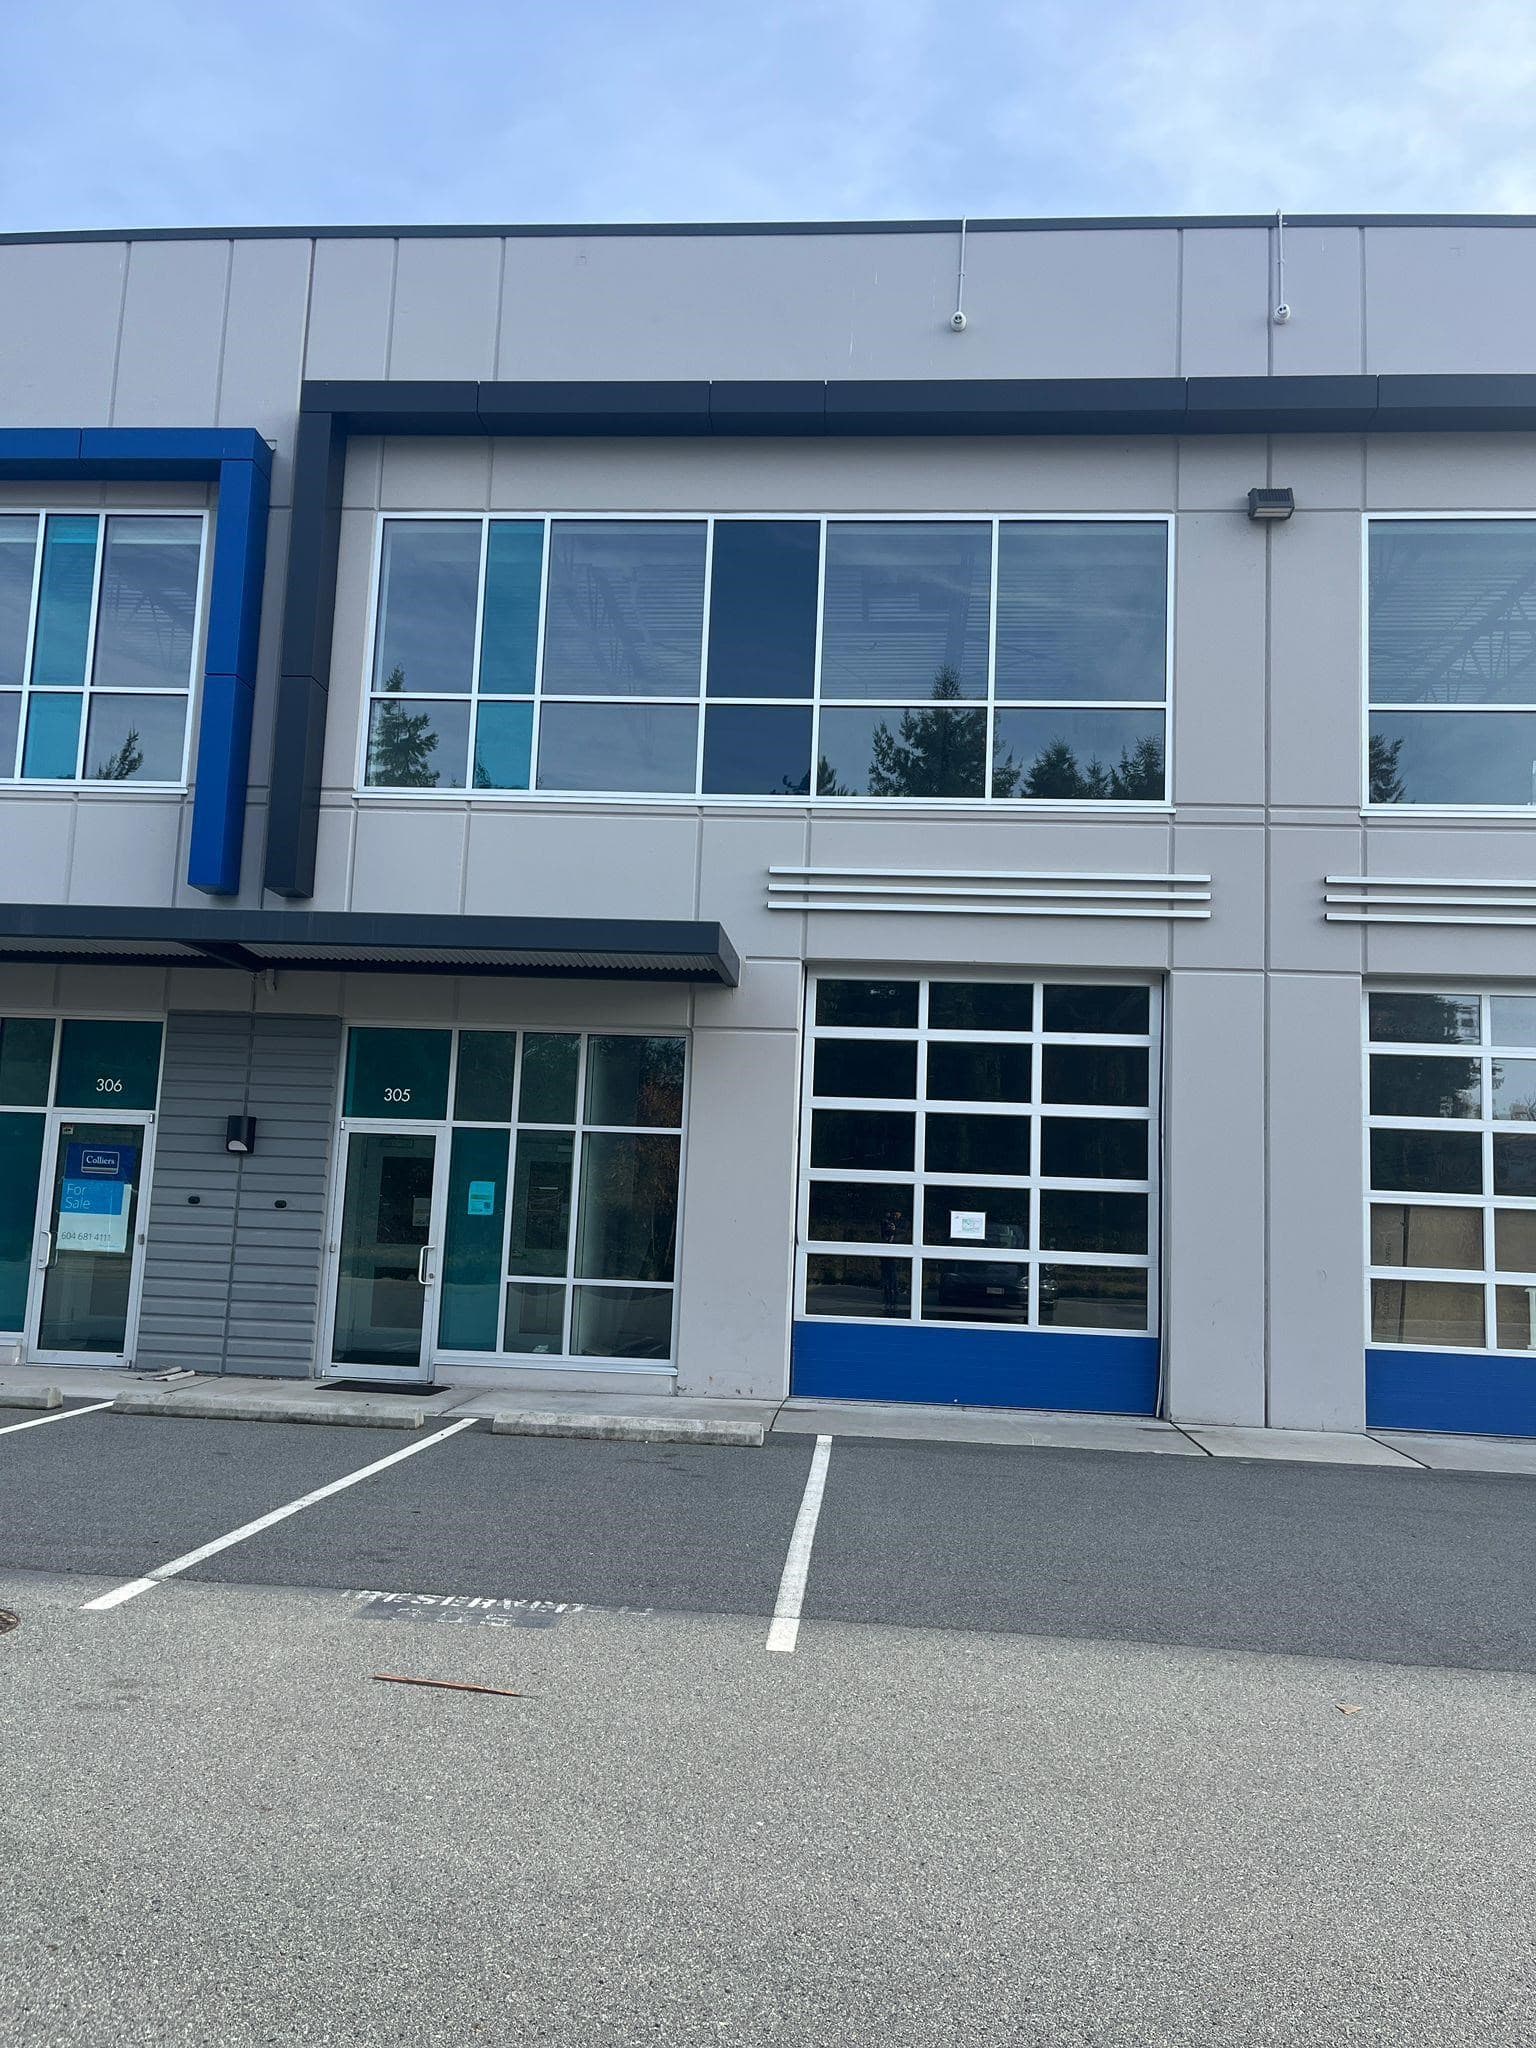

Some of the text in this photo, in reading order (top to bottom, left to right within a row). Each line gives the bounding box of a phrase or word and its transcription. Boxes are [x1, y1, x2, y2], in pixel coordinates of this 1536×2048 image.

[96, 1078, 123, 1092] 306
[384, 1088, 411, 1102] 305
[86, 1155, 115, 1165] Colliers
[66, 1183, 88, 1196] For
[65, 1196, 91, 1210] Sale
[61, 1231, 76, 1240] 604
